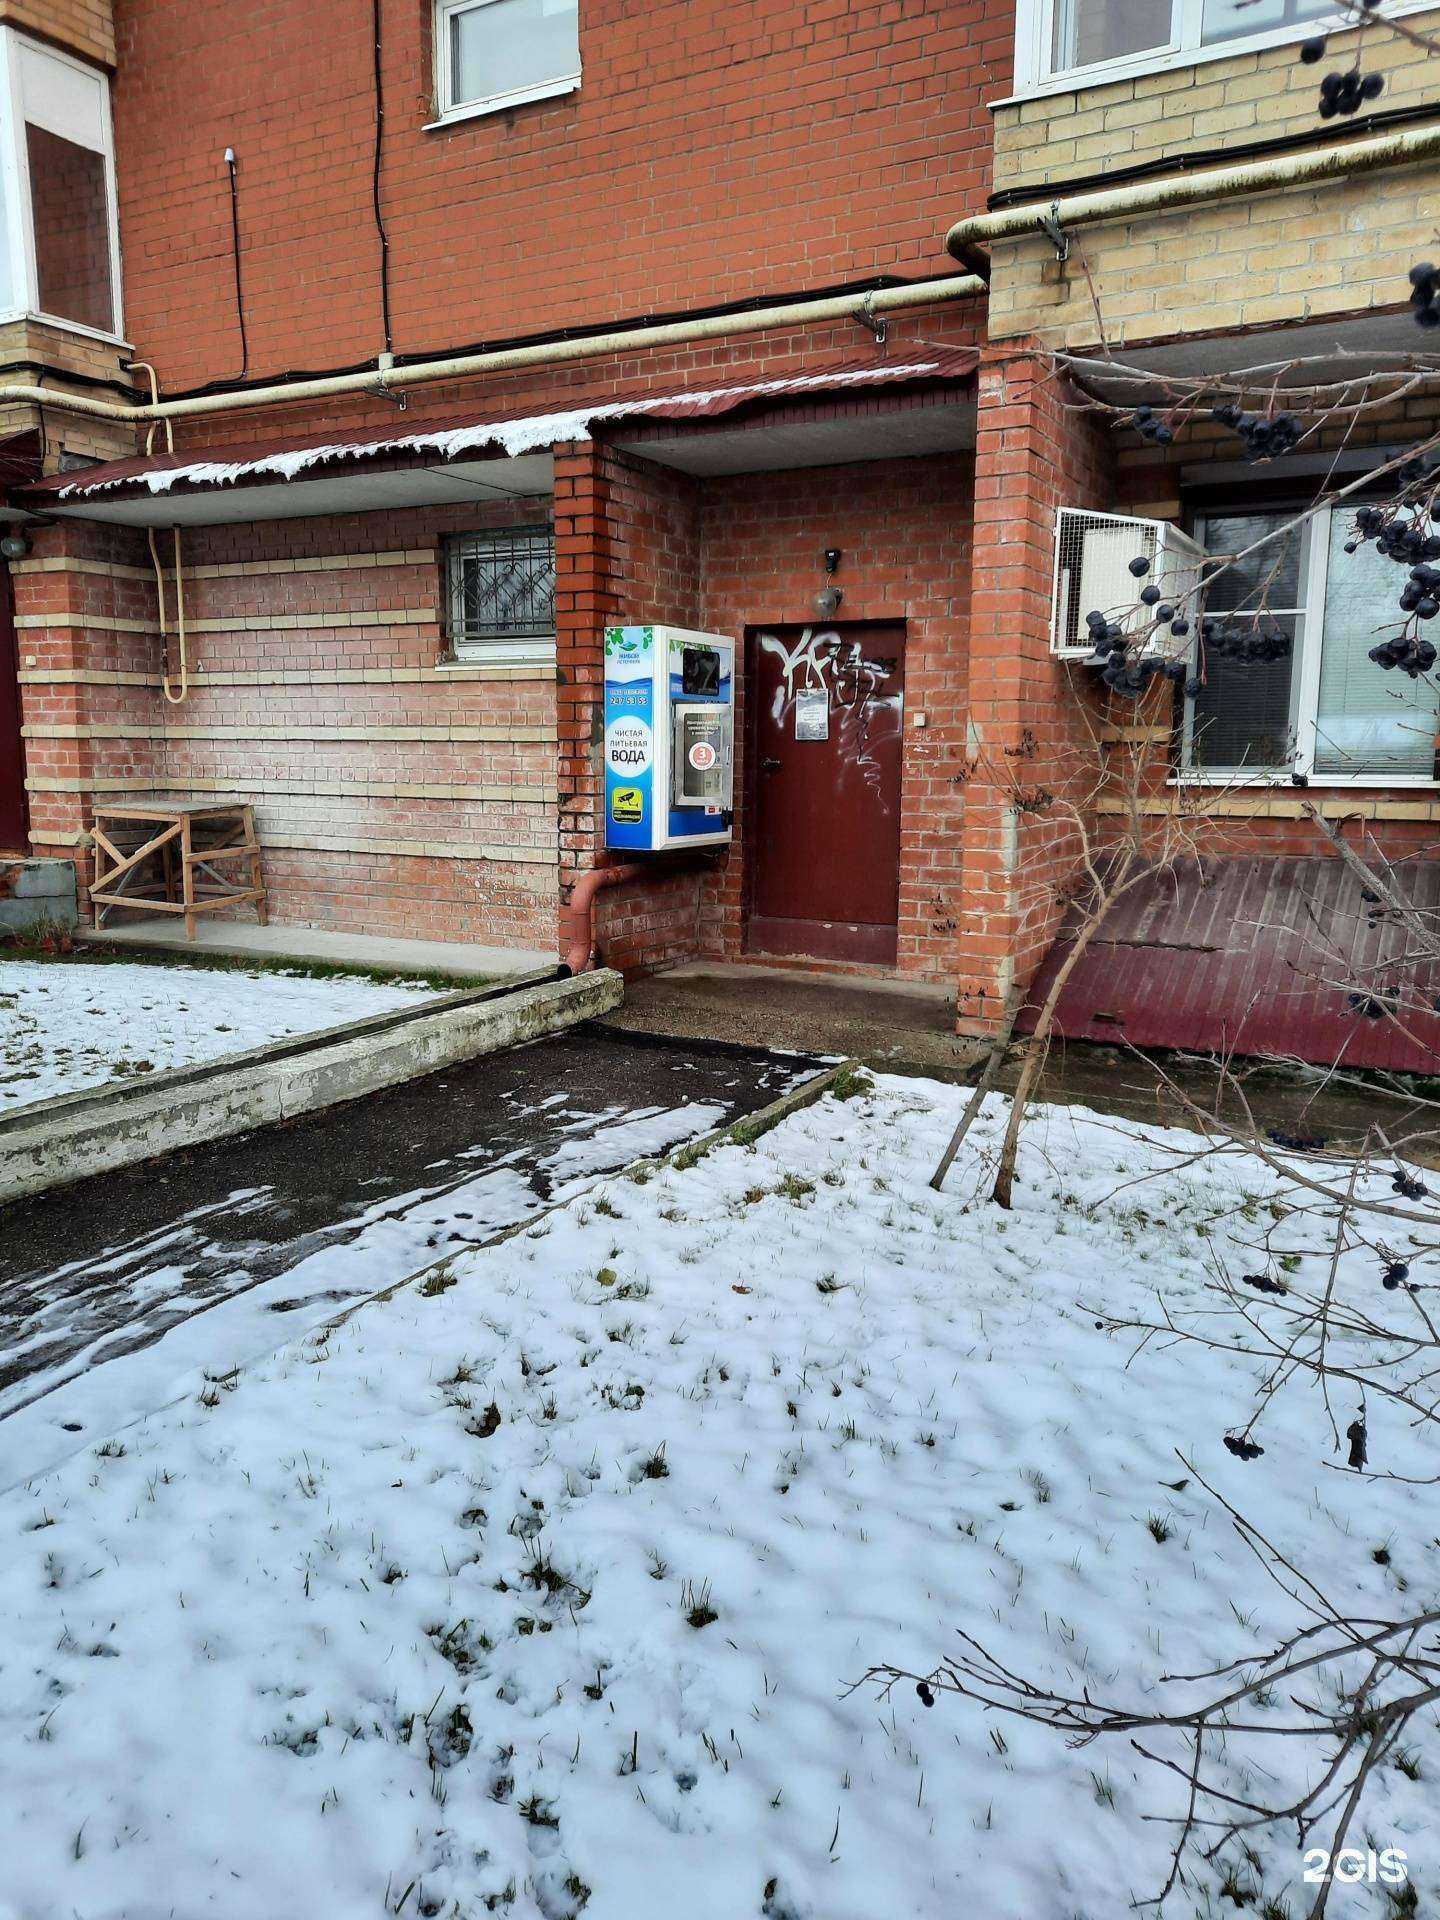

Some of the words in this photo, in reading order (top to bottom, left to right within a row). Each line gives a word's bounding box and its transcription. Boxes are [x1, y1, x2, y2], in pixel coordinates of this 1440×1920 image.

[614, 729, 643, 737] ЧИСТАЯ
[609, 740, 648, 748] ПИТЬЕВАЯ
[611, 749, 646, 765] ВОДА
